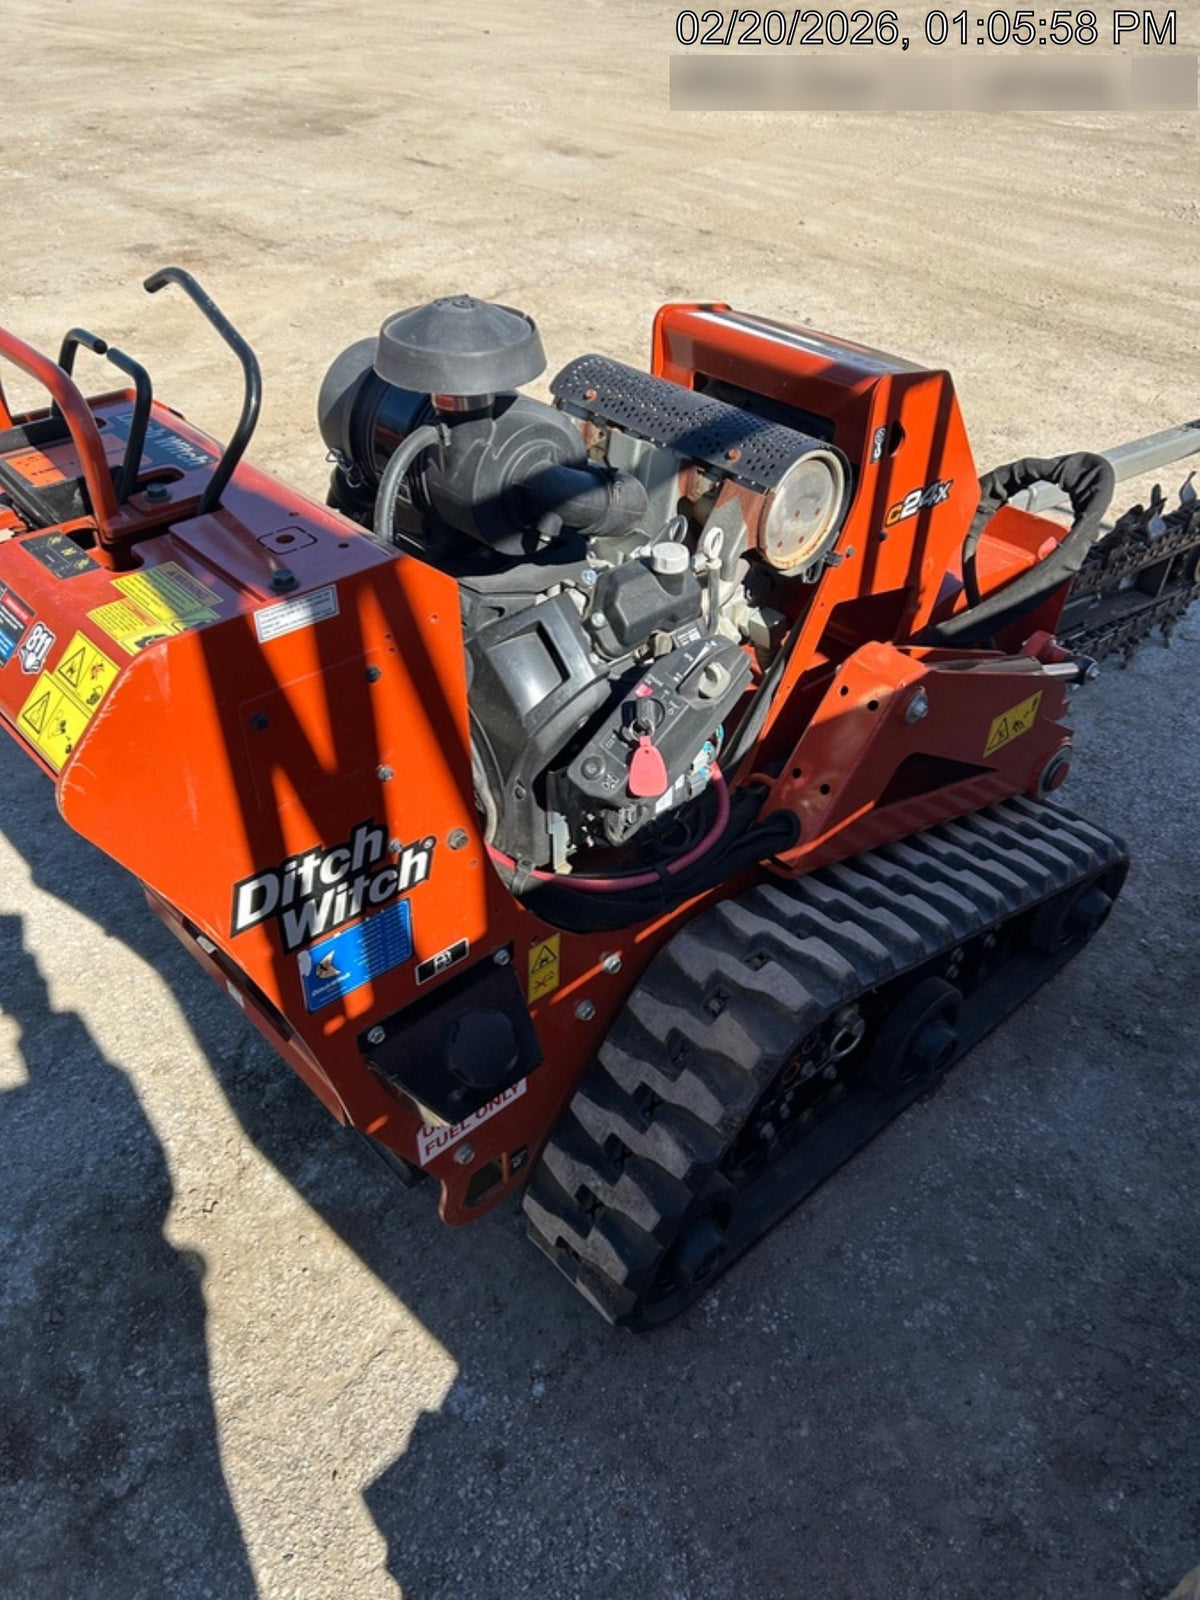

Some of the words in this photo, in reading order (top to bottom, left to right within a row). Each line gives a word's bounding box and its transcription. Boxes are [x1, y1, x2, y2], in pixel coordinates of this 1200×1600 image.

[27, 624, 54, 656] 811
[236, 825, 384, 931] Ditch
[282, 848, 430, 950] Witch
[424, 1121, 472, 1156] FUEL
[475, 1083, 519, 1119] ONLY
